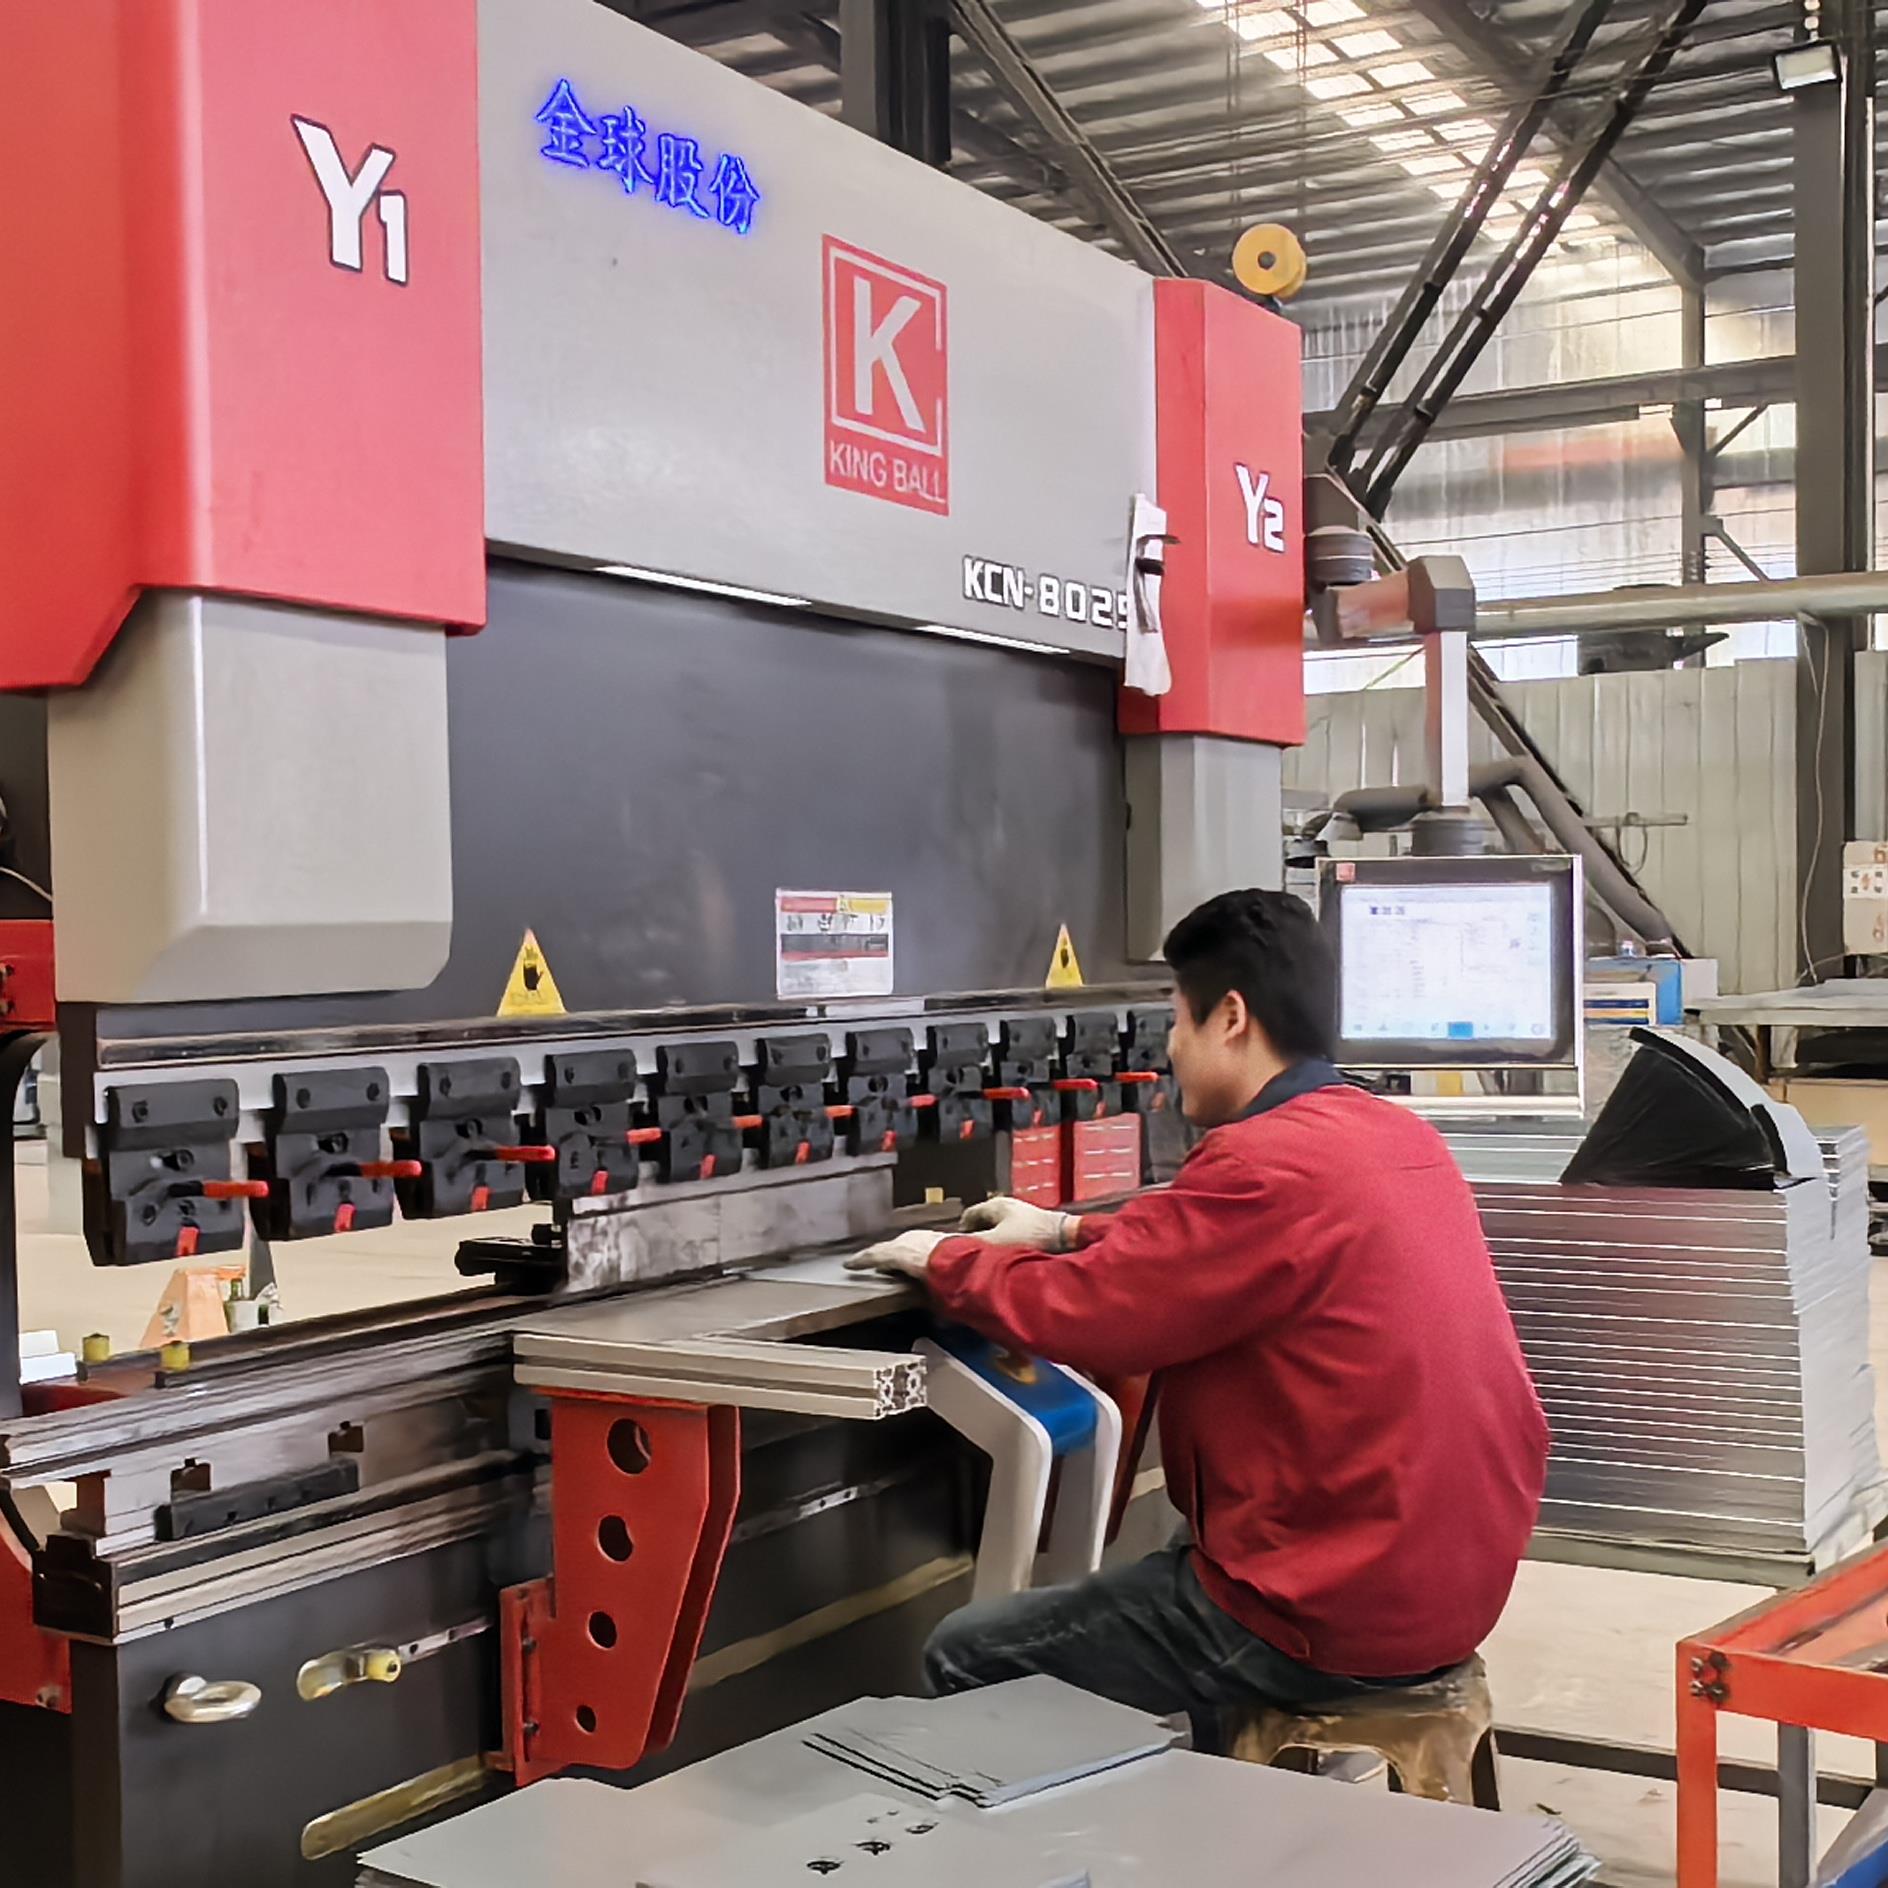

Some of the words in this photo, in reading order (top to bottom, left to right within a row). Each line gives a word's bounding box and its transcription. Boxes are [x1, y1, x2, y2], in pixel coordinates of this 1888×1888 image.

[536, 79, 760, 234] 金球股份
[854, 275, 926, 433] K
[830, 440, 887, 488] KING
[893, 459, 945, 503] BALL
[1234, 462, 1285, 553] Y2
